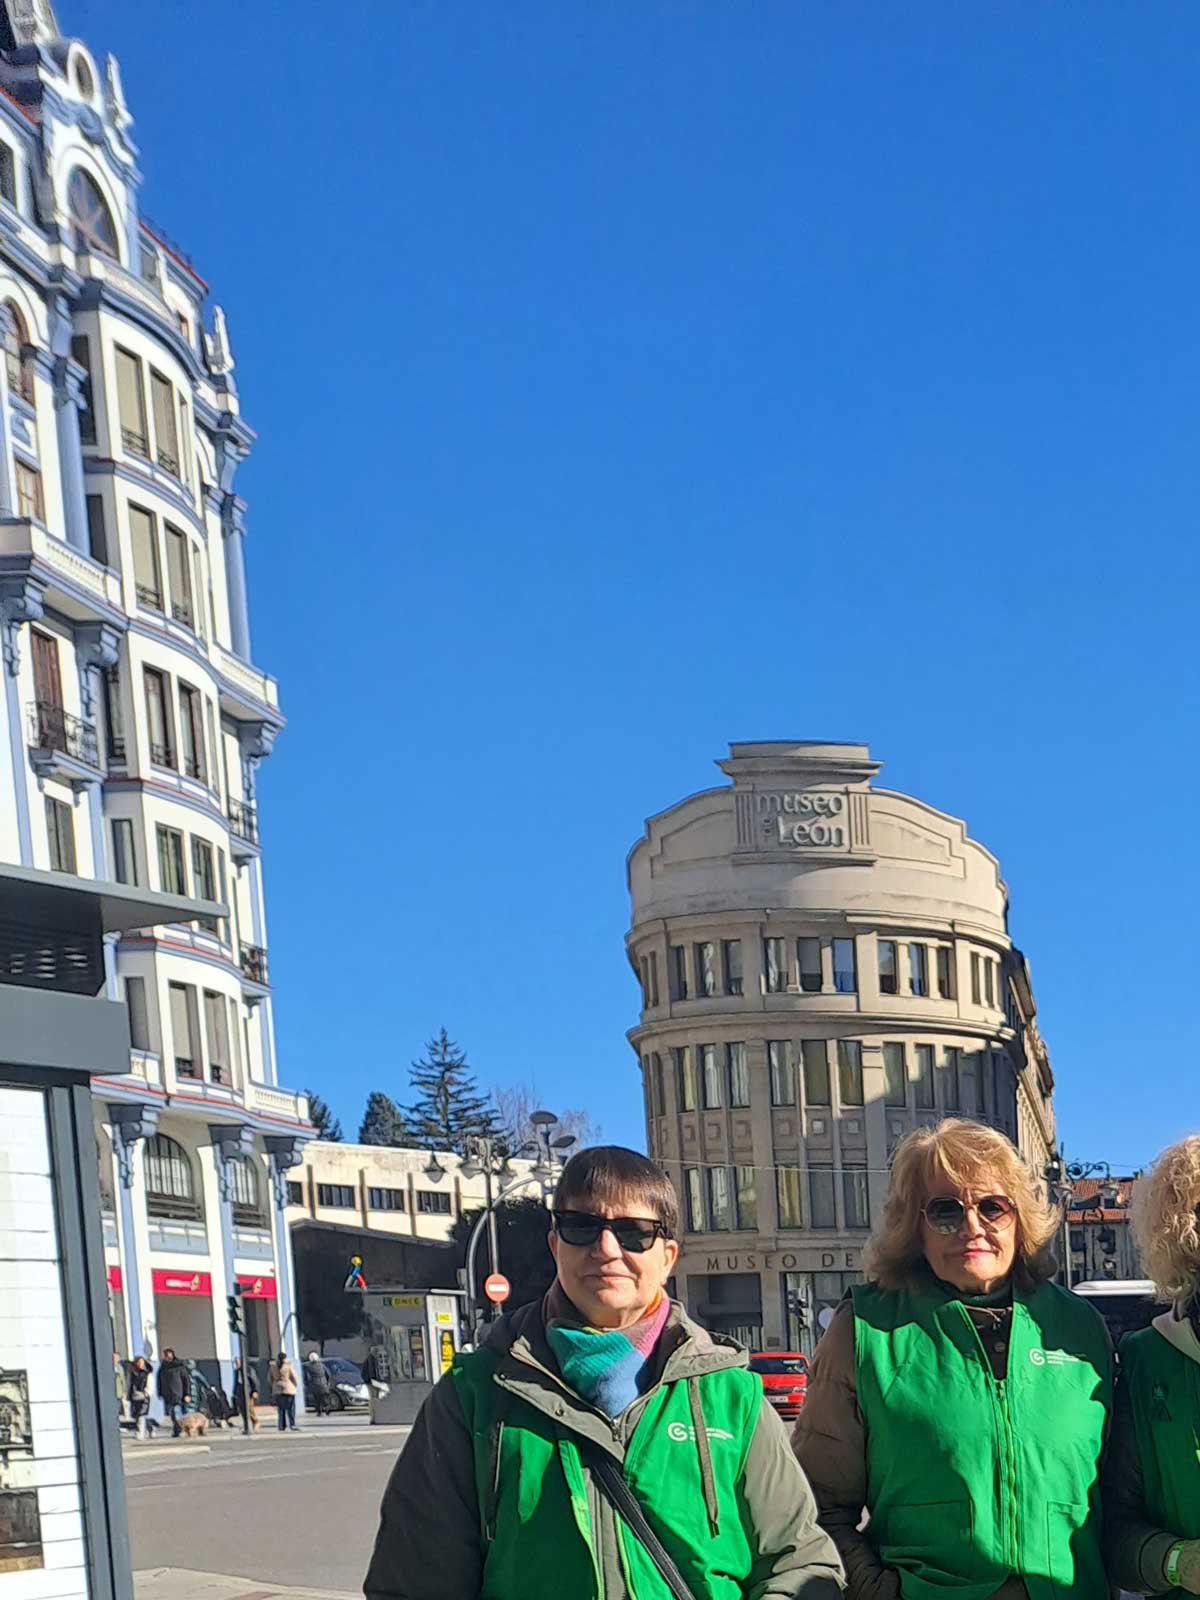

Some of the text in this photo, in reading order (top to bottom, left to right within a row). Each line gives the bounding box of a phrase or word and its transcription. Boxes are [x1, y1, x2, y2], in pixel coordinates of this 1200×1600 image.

[756, 793, 843, 814] museo
[706, 1253, 854, 1271] MUSEO DE
